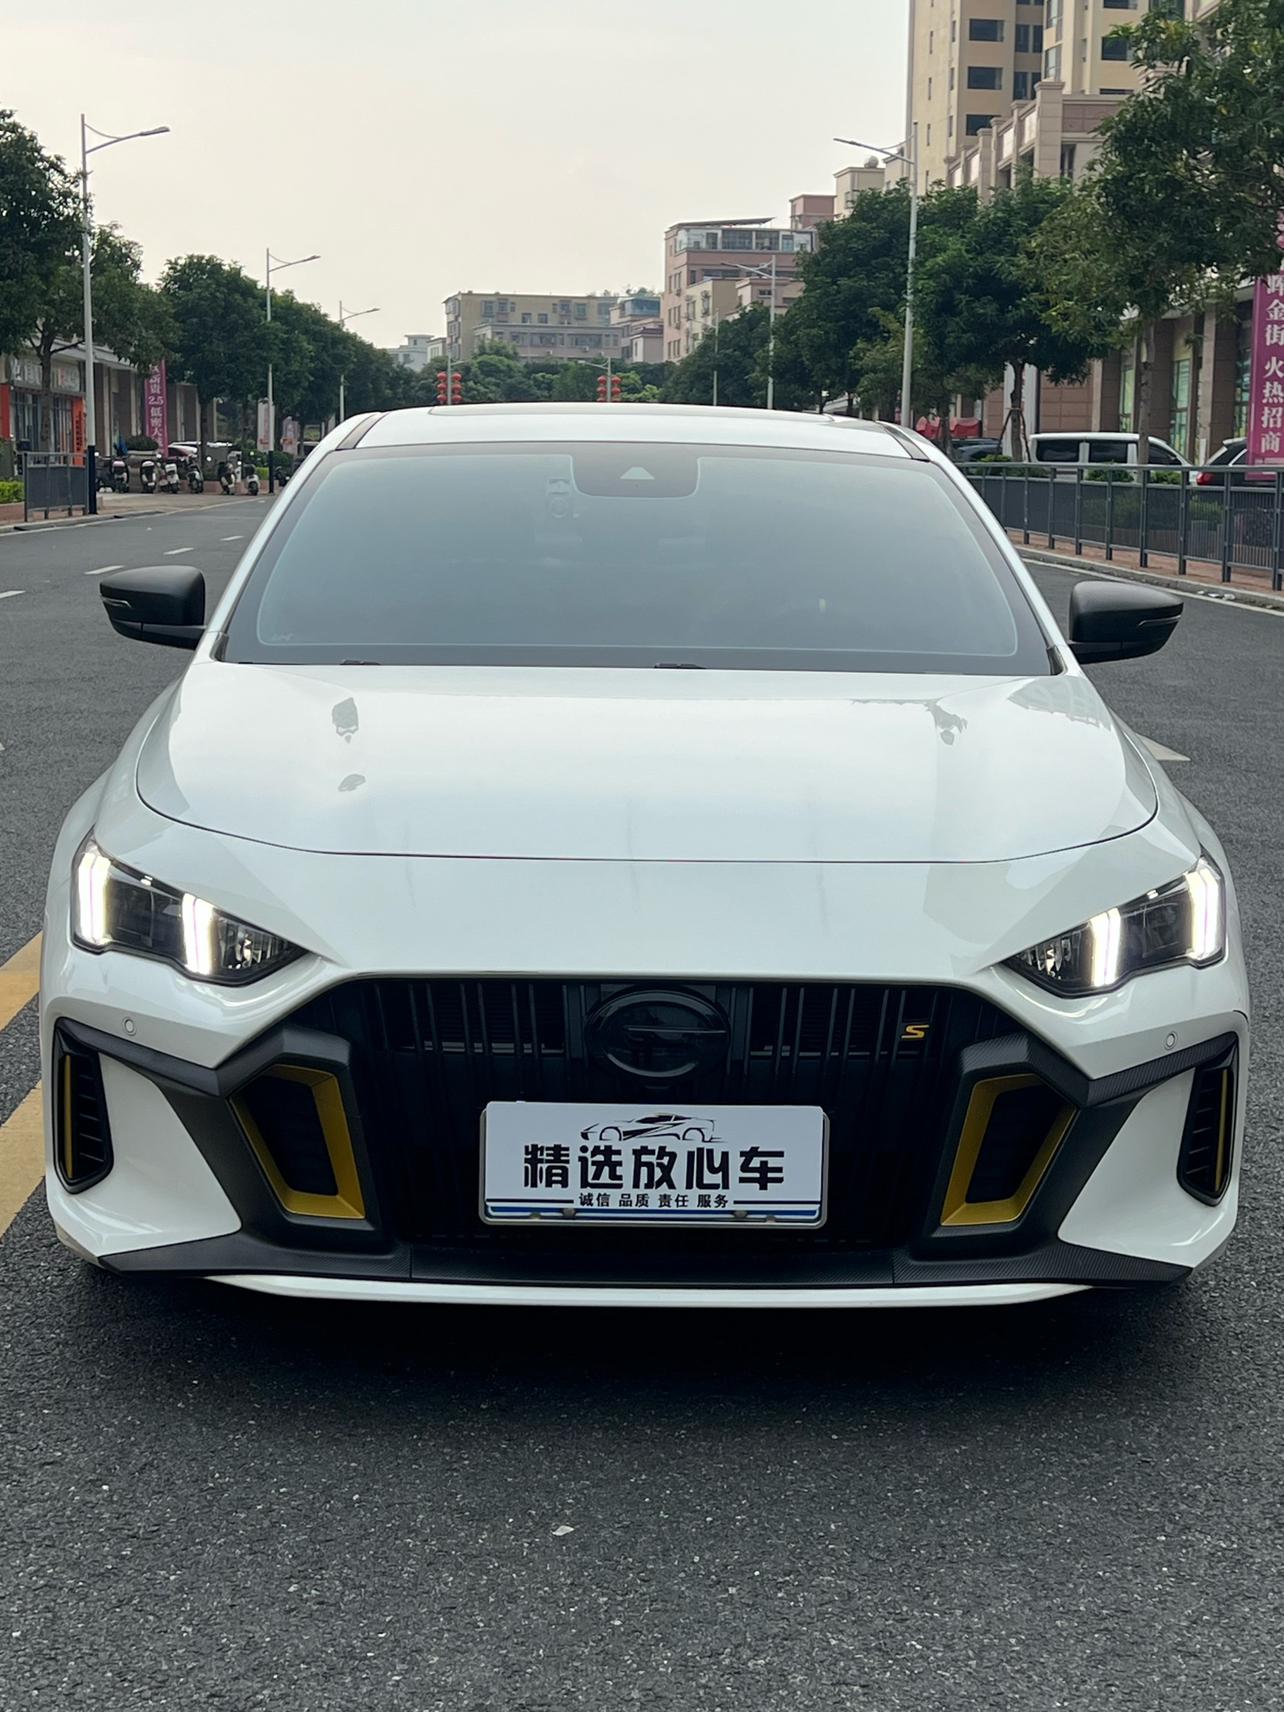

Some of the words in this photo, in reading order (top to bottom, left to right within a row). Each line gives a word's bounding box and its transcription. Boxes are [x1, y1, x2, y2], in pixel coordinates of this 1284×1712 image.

[901, 1024, 930, 1039] S
[524, 1144, 785, 1191] 精选放心车
[579, 1192, 611, 1207] 诚信
[619, 1193, 649, 1207] 品质
[658, 1193, 688, 1208] 责任
[697, 1194, 728, 1208] 服务
